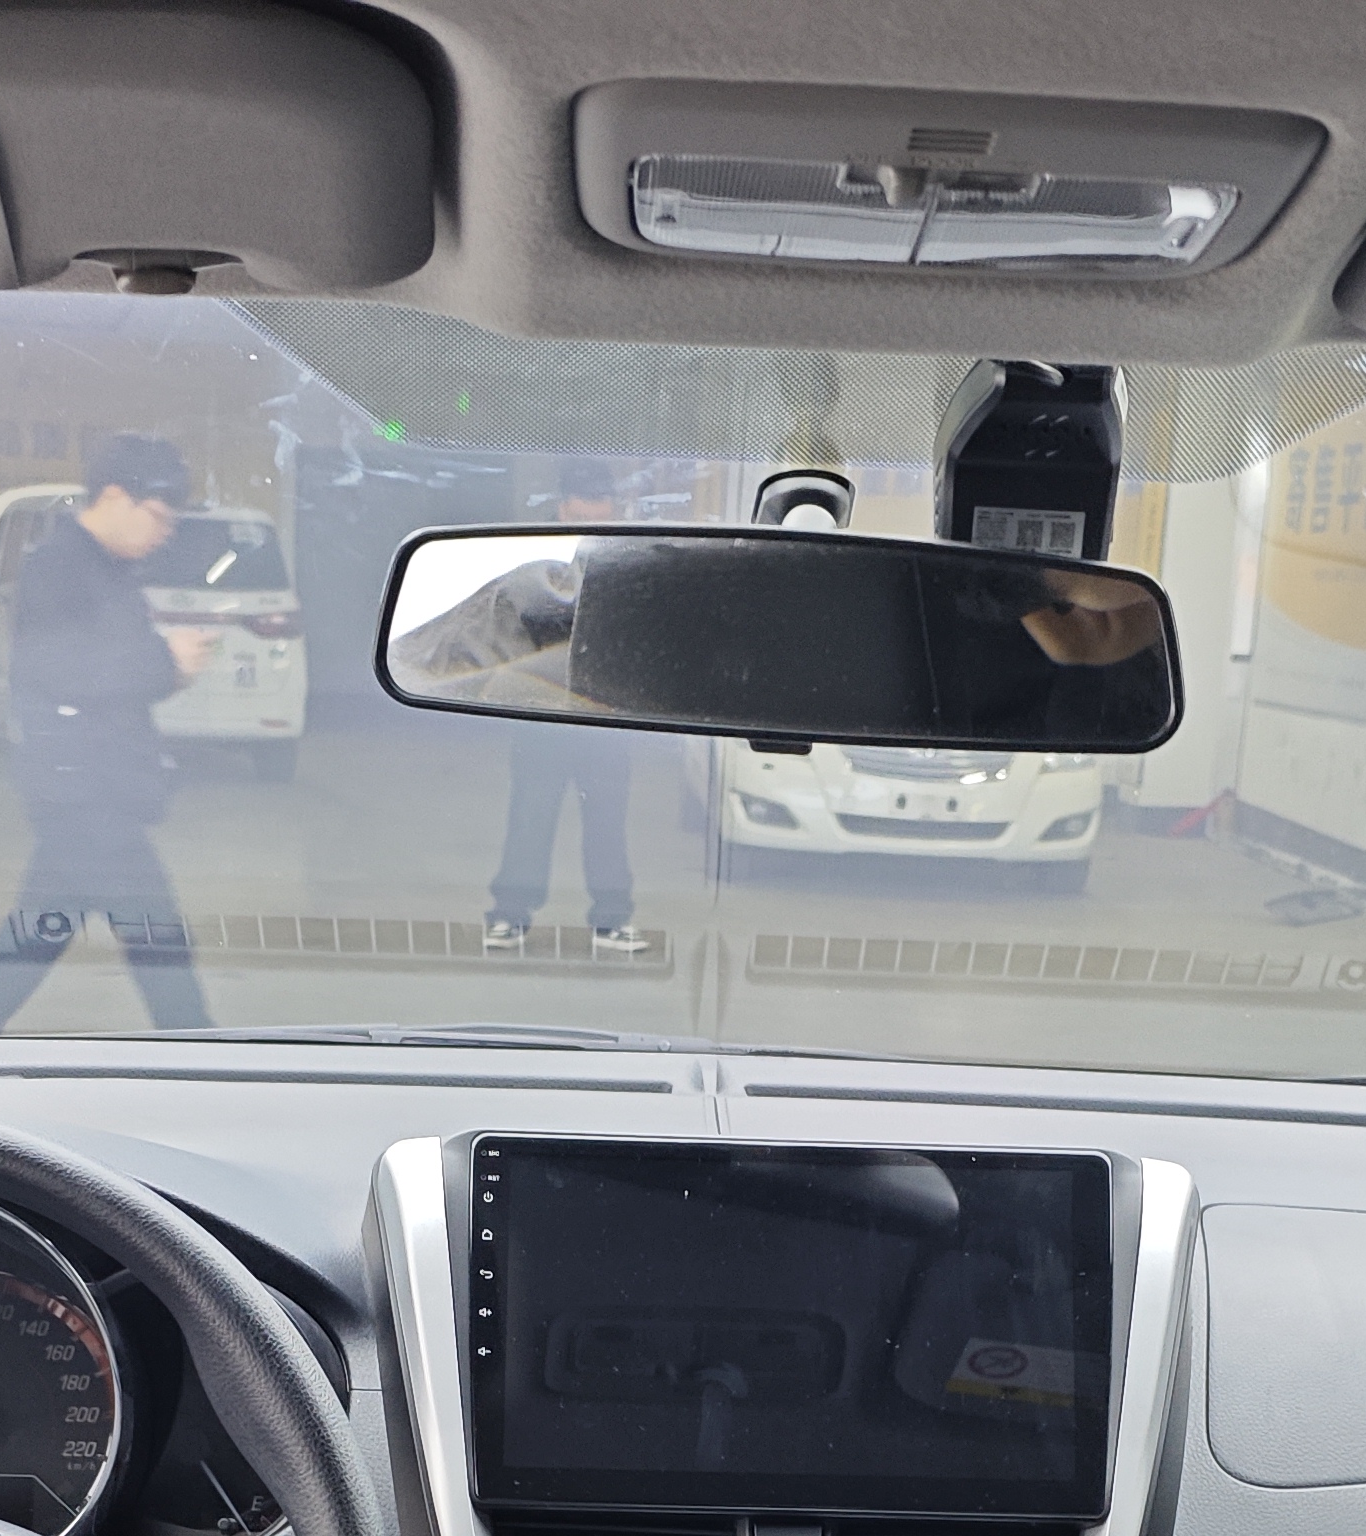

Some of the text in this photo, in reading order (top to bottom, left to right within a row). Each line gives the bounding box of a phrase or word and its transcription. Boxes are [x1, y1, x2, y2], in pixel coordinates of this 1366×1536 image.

[19, 1320, 49, 1336] 140
[46, 1345, 75, 1361] 160
[60, 1375, 89, 1391] 180
[65, 1406, 99, 1423] 200
[63, 1441, 96, 1457] 220
[251, 1495, 264, 1511] E
